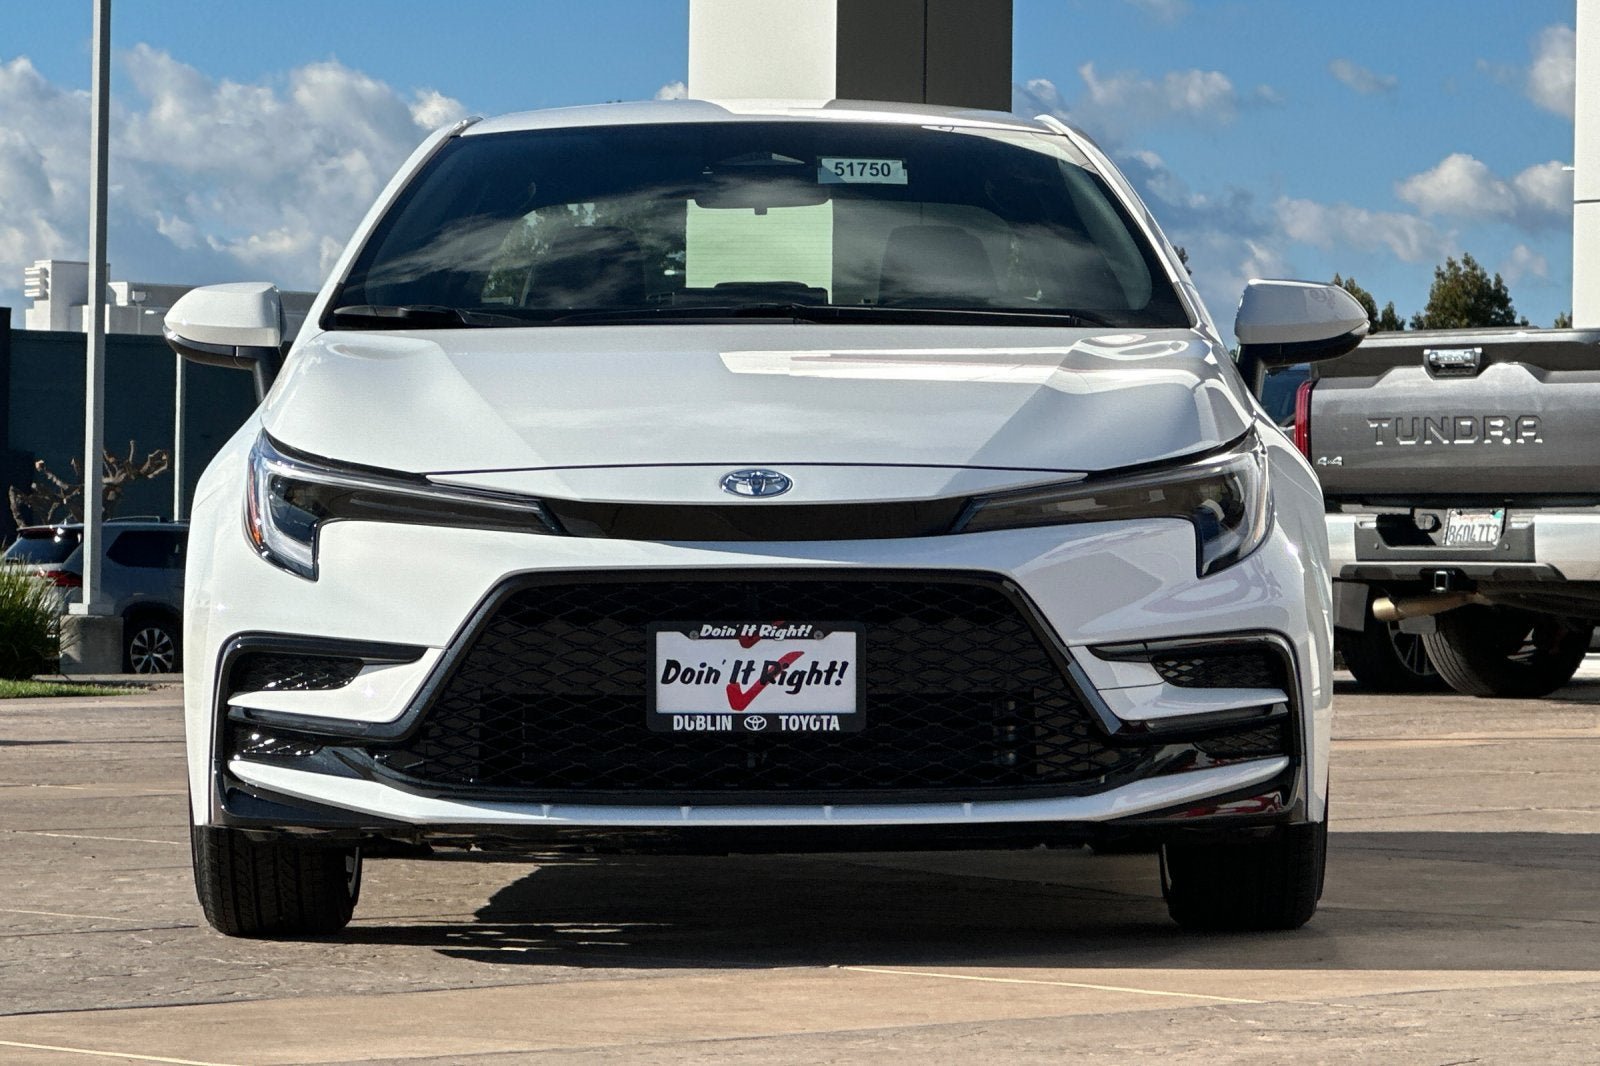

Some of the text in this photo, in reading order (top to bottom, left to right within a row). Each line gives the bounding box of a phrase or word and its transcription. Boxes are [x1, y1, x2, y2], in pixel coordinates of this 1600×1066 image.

[834, 162, 891, 177] 51750
[1367, 415, 1543, 446] TUNDRA
[700, 624, 813, 641] Doin' It Right!
[661, 659, 849, 695] Doin' It Right!
[673, 715, 840, 731] DUBLIN TOYOTA
